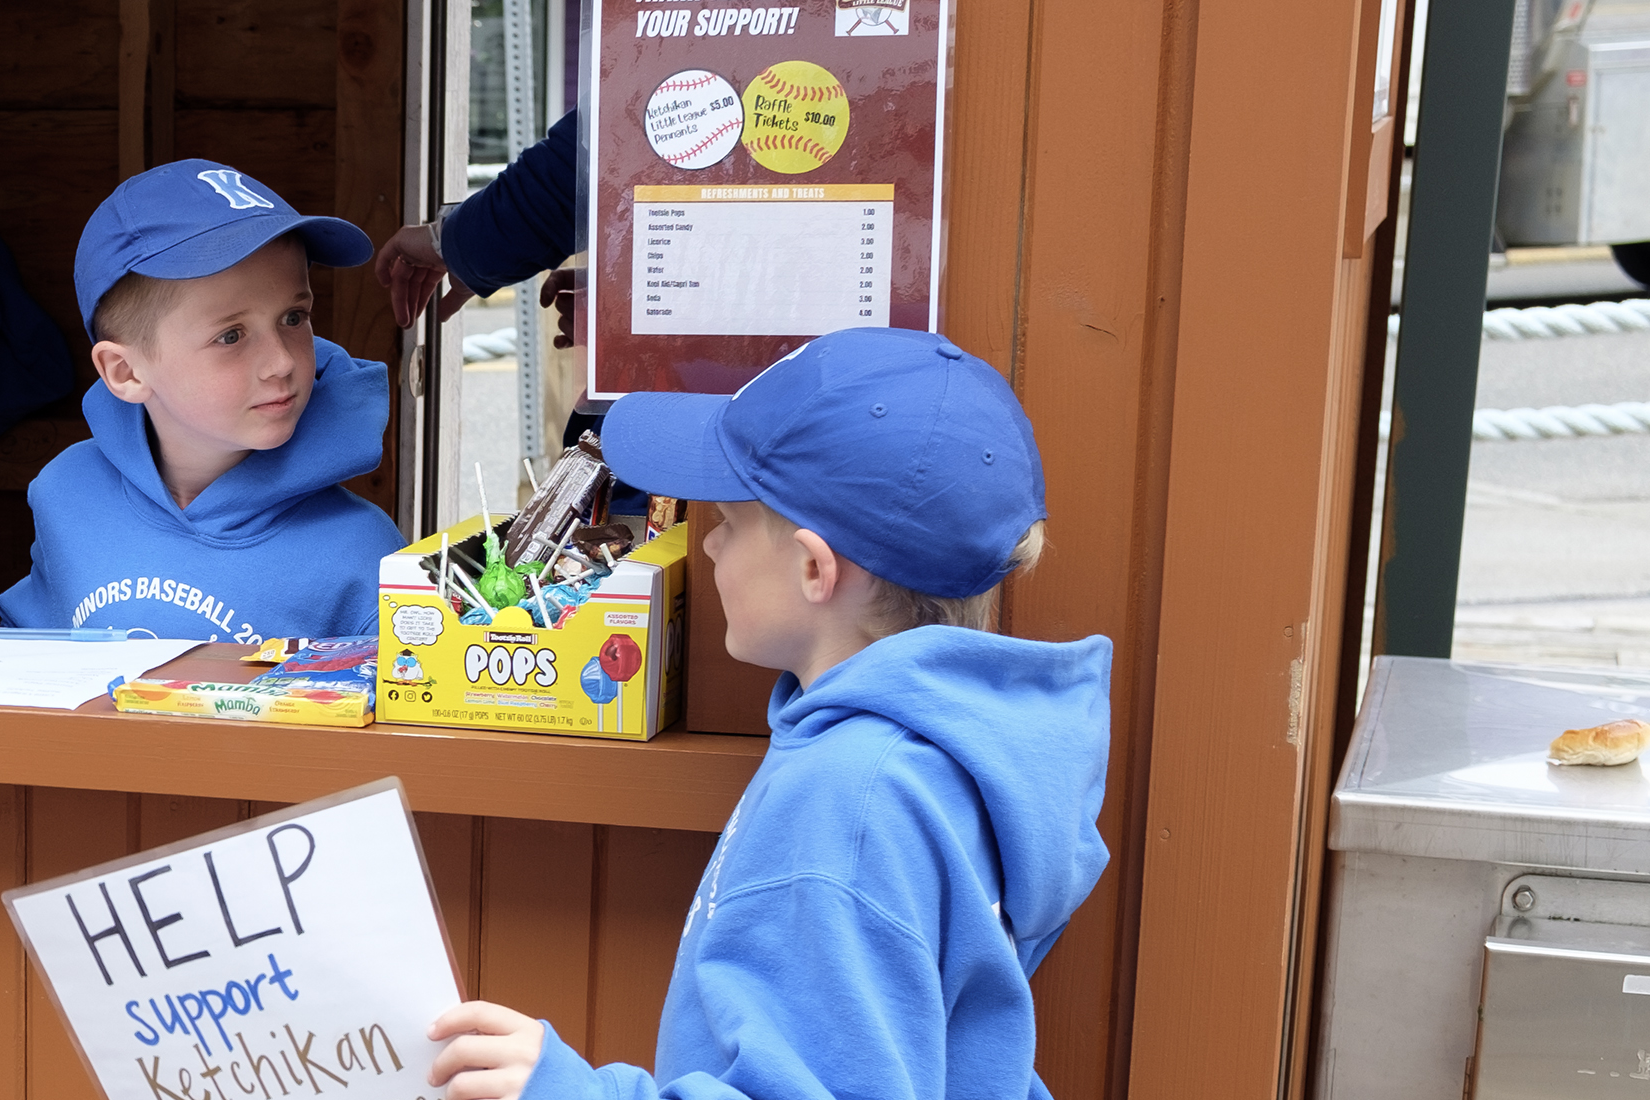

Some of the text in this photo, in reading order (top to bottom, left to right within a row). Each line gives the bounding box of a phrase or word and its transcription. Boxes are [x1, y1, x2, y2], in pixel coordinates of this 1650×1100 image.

[634, 6, 800, 38] YOUR SUPPORT!
[709, 95, 735, 111] $5.00
[754, 94, 793, 113] Raffle
[646, 99, 692, 121] Ketchikan
[650, 107, 709, 132] Little League
[753, 112, 799, 132] Tickets
[804, 111, 836, 127] $10.00
[653, 124, 699, 145] Pennants
[197, 169, 275, 210] K
[701, 187, 825, 199] REFRESHMENTS AND TREATS
[862, 208, 876, 216] 1.00
[647, 223, 694, 232] Assorted Candy
[861, 223, 875, 231] 2.00
[647, 237, 672, 246] Licorice
[860, 237, 875, 246] 3.00
[647, 252, 664, 260] Chips
[859, 252, 874, 260] 2.00
[859, 266, 873, 275] 2.00
[859, 281, 873, 289] 2.00
[646, 294, 661, 302] Soda
[858, 295, 873, 303] 3.00
[646, 308, 673, 316] Gatorade
[858, 309, 873, 317] 4.00
[71, 577, 133, 629] MINORS
[134, 576, 236, 634] BASEBALL
[606, 613, 639, 621] ASSORTED
[490, 633, 532, 643] Tootsie Roll
[464, 644, 558, 687] POPS
[213, 697, 262, 717] Mamba
[474, 711, 489, 720] POPS
[495, 712, 507, 721] NET
[507, 713, 516, 722] WT
[516, 714, 524, 722] 60
[64, 822, 317, 986] HELP
[125, 952, 300, 1058] support
